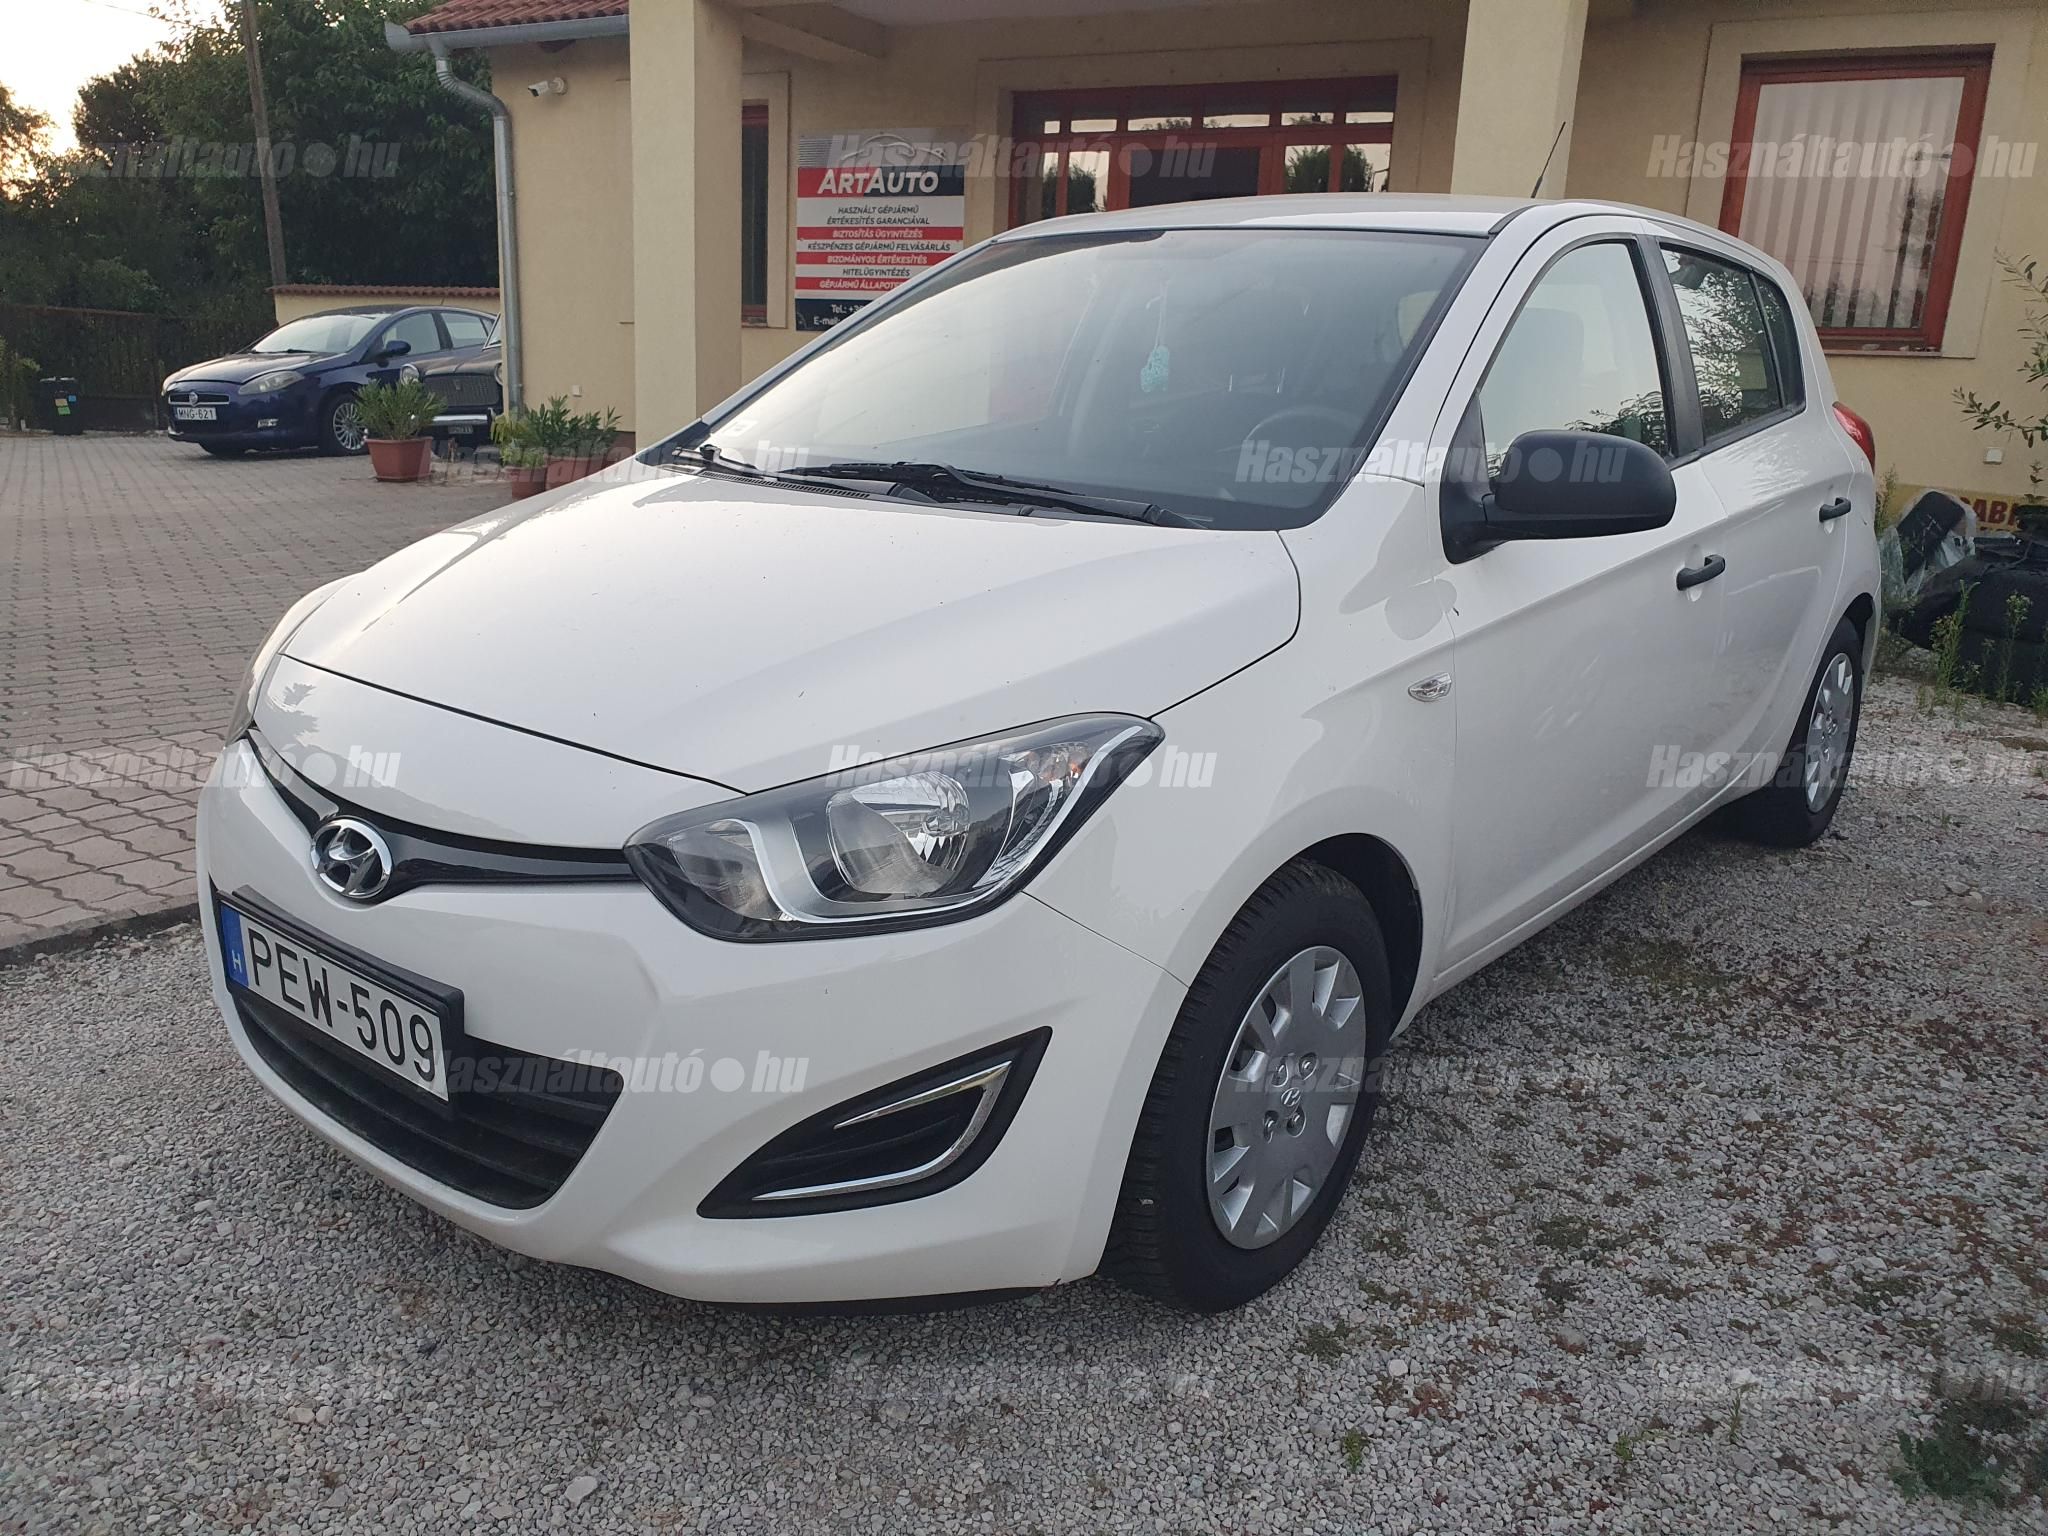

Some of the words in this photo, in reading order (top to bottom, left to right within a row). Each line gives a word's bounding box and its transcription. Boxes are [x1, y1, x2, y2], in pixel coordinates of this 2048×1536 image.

[838, 205, 876, 214] HASZNÁLT
[827, 216, 875, 225] ÉRTÉKESÍTÉS
[876, 215, 930, 225] GARANCIÁVAL
[832, 228, 874, 238] BIZTOSÍTÁS
[807, 241, 853, 250] KÉSZPÉNZES
[896, 241, 951, 251] FELVÁSÁRLÁS
[231, 950, 241, 972] H
[248, 927, 435, 1082] PEW-509
